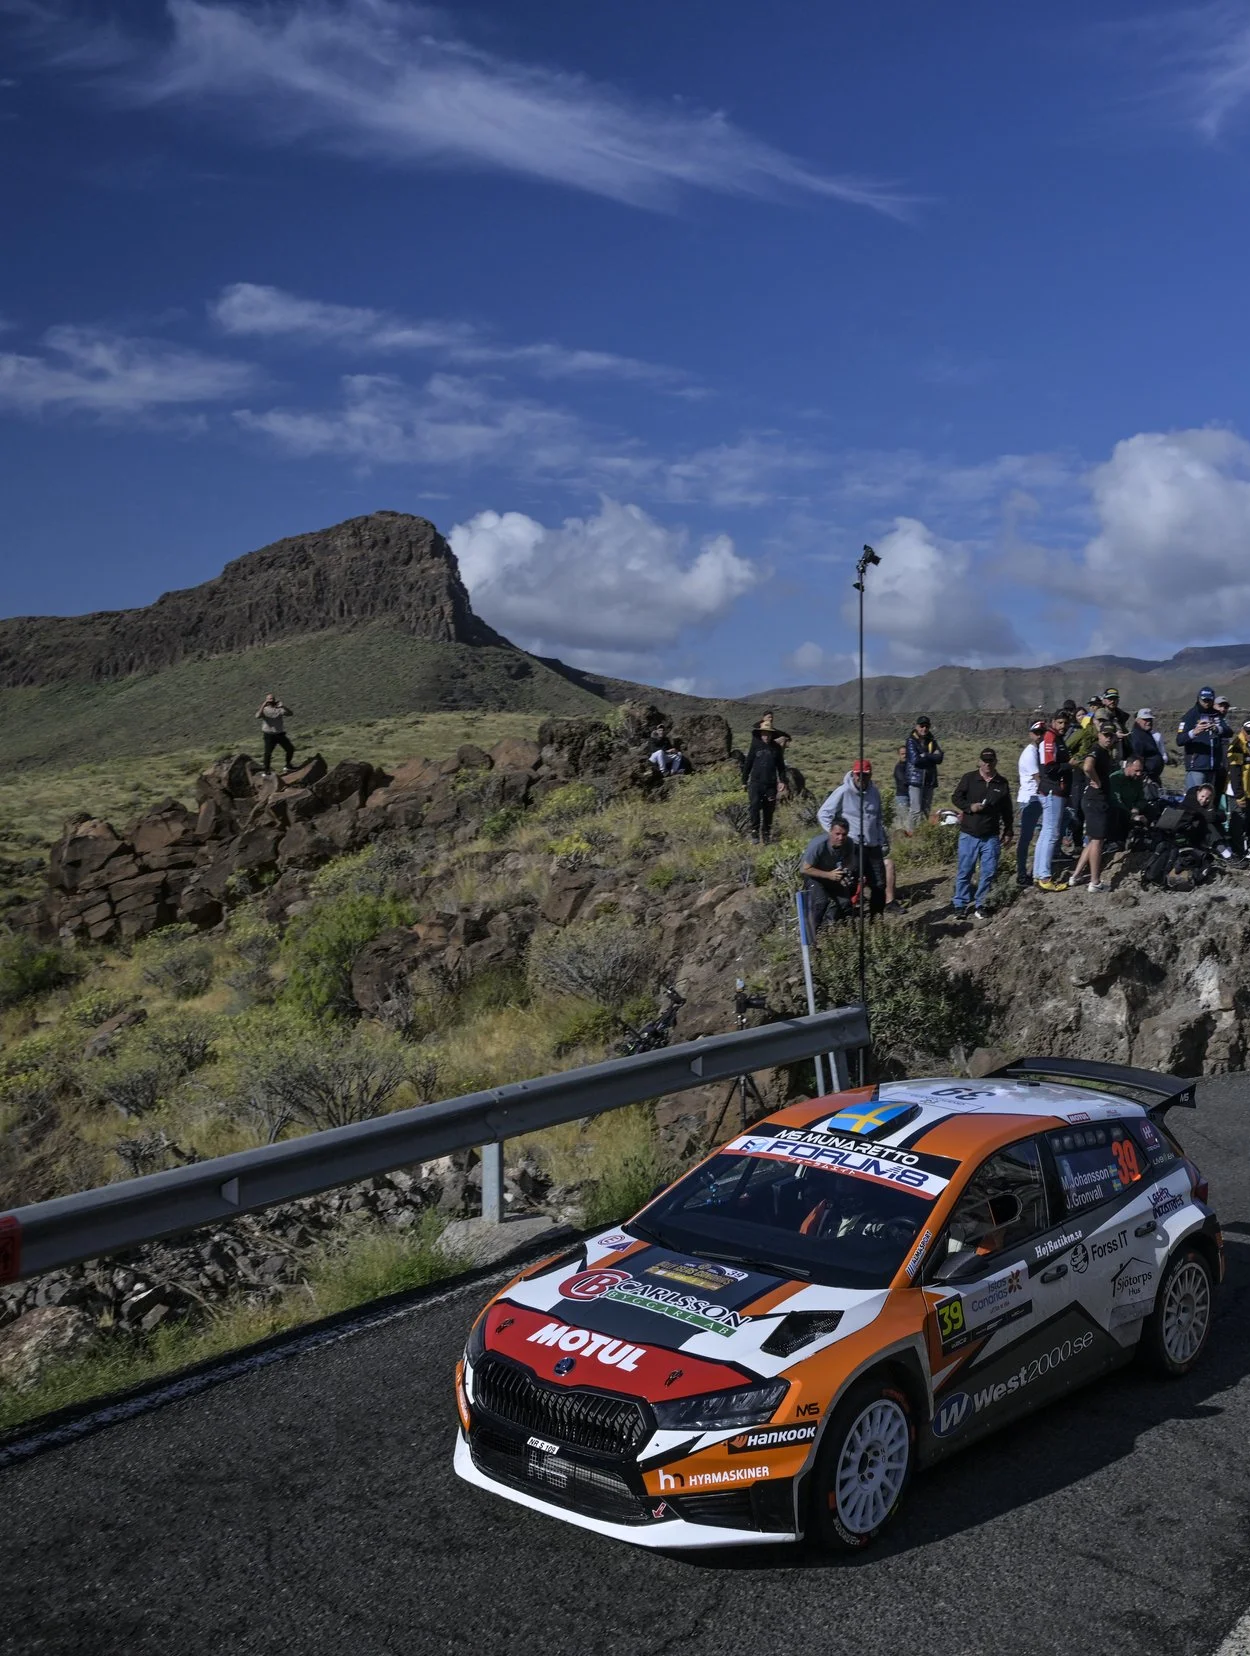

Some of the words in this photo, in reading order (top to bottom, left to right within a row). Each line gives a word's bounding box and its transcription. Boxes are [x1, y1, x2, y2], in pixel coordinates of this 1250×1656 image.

[1069, 1113, 1089, 1121] MOTUL
[766, 1140, 929, 1188] FORUM8
[803, 1133, 920, 1165] MUNARETTO
[1112, 1139, 1141, 1184] 39
[1091, 1240, 1119, 1261] Forss
[1118, 1230, 1128, 1249] IT
[727, 1270, 744, 1278] 39
[1117, 1271, 1152, 1293] Sjötorps
[615, 1279, 751, 1328] CARLSSON
[971, 1288, 1008, 1312] Canarias
[1128, 1287, 1141, 1296] Hus
[607, 1291, 693, 1321] BYGGARE
[704, 1322, 730, 1335] AB
[938, 1300, 964, 1336] 39
[526, 1322, 647, 1372] MOTUL
[973, 1331, 1094, 1413] West2000.se
[796, 1402, 820, 1417] MS
[689, 1466, 769, 1487] HYRMASKINER
